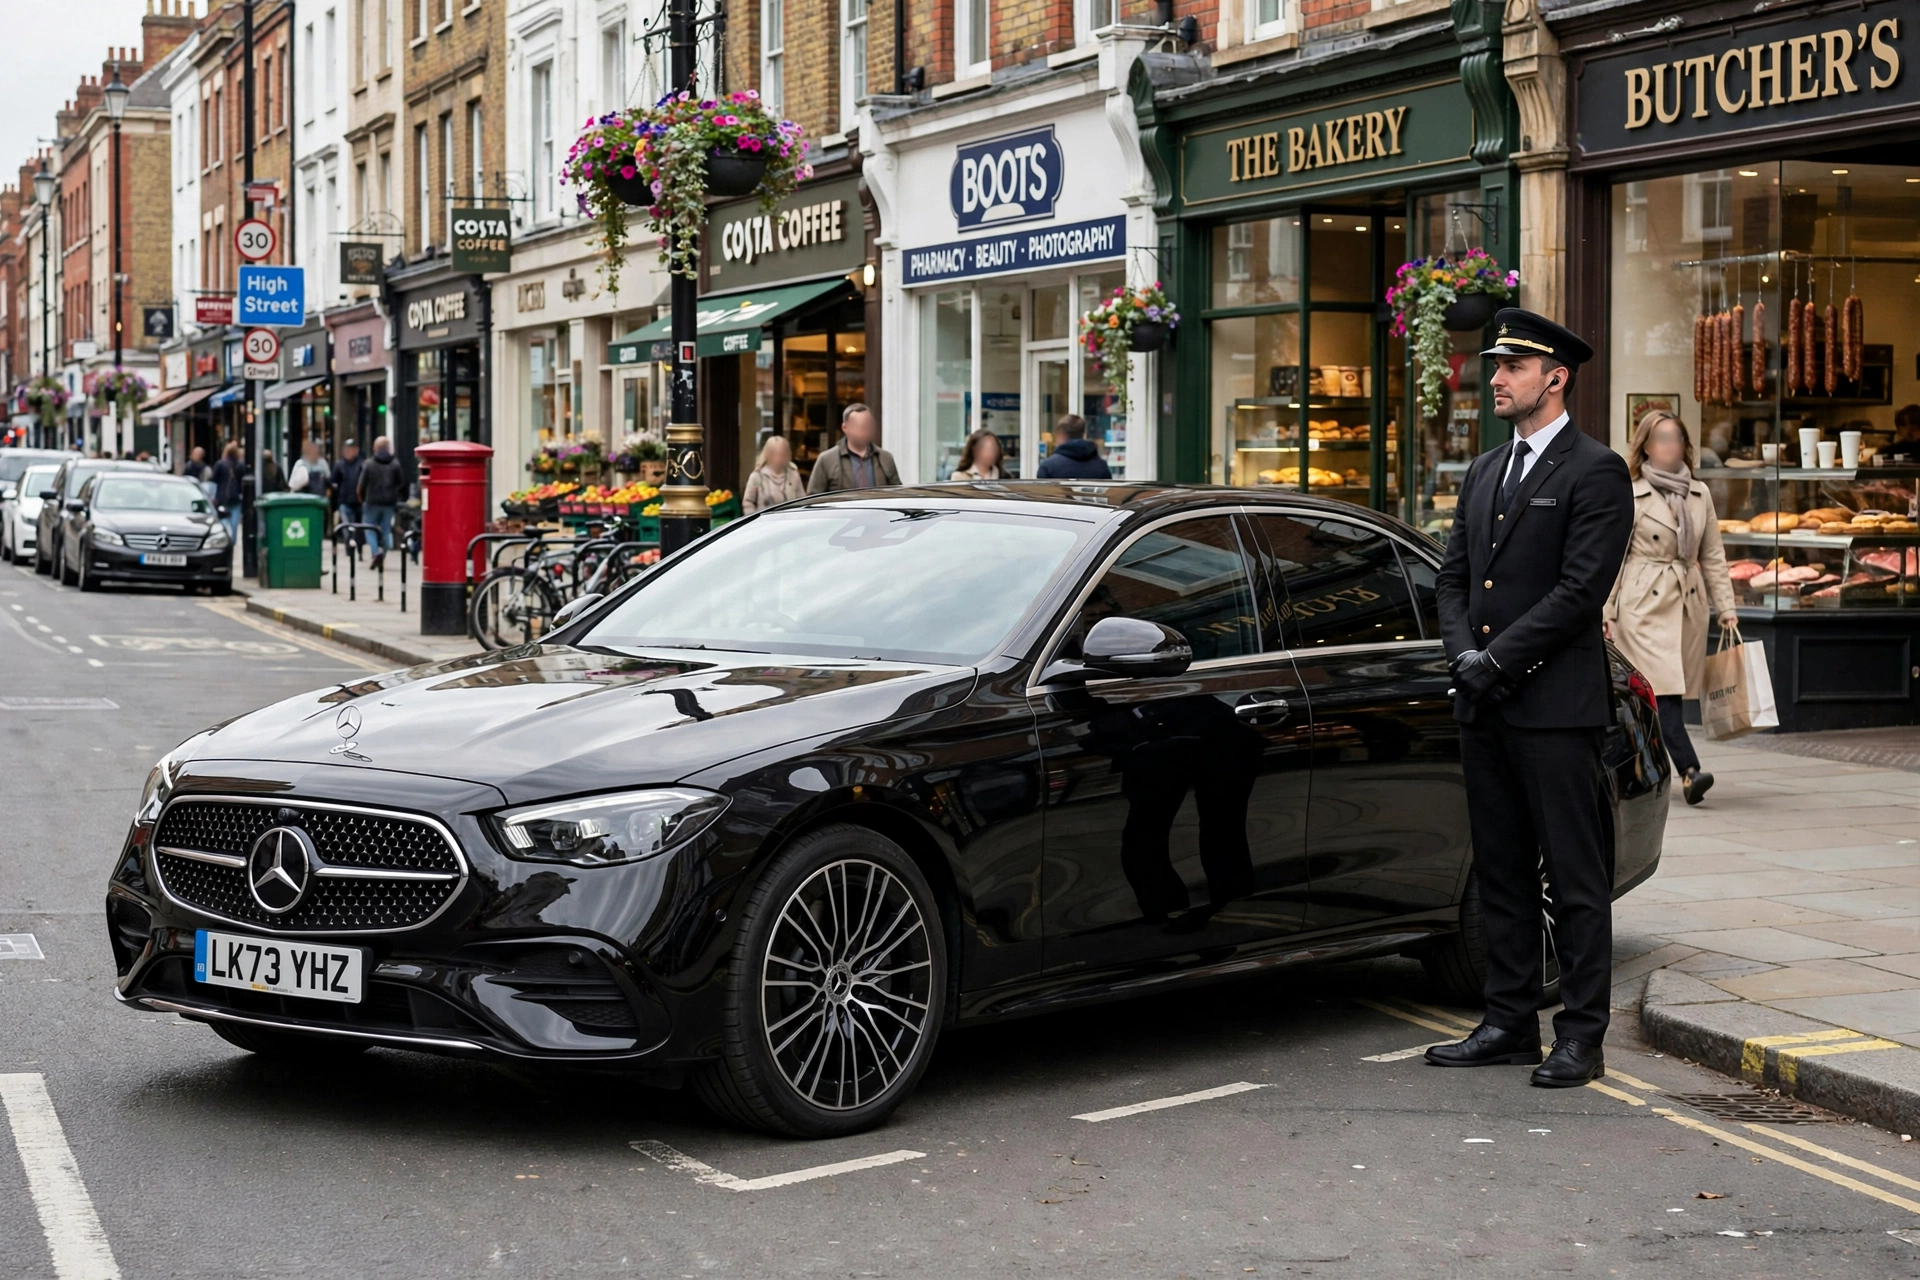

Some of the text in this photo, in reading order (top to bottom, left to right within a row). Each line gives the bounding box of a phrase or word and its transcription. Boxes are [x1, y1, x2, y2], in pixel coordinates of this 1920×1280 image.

[1624, 18, 1899, 130] BUTCHER'S
[1226, 106, 1407, 182] THE BAKERY
[962, 143, 1048, 213] BOOTS
[242, 232, 269, 249] 30
[454, 219, 508, 239] COSTA
[722, 199, 842, 264] COSTA COFFEE
[456, 239, 506, 251] COFFEE
[910, 224, 1116, 277] PHARMACY BEAUTY PHOTOGRAPHY
[247, 275, 288, 295] High
[244, 296, 299, 313] Street
[408, 291, 465, 331] COSTA COFFEE
[249, 338, 273, 354] 30
[723, 333, 749, 351] COFFEE
[211, 938, 349, 994] LK73 YHZ
